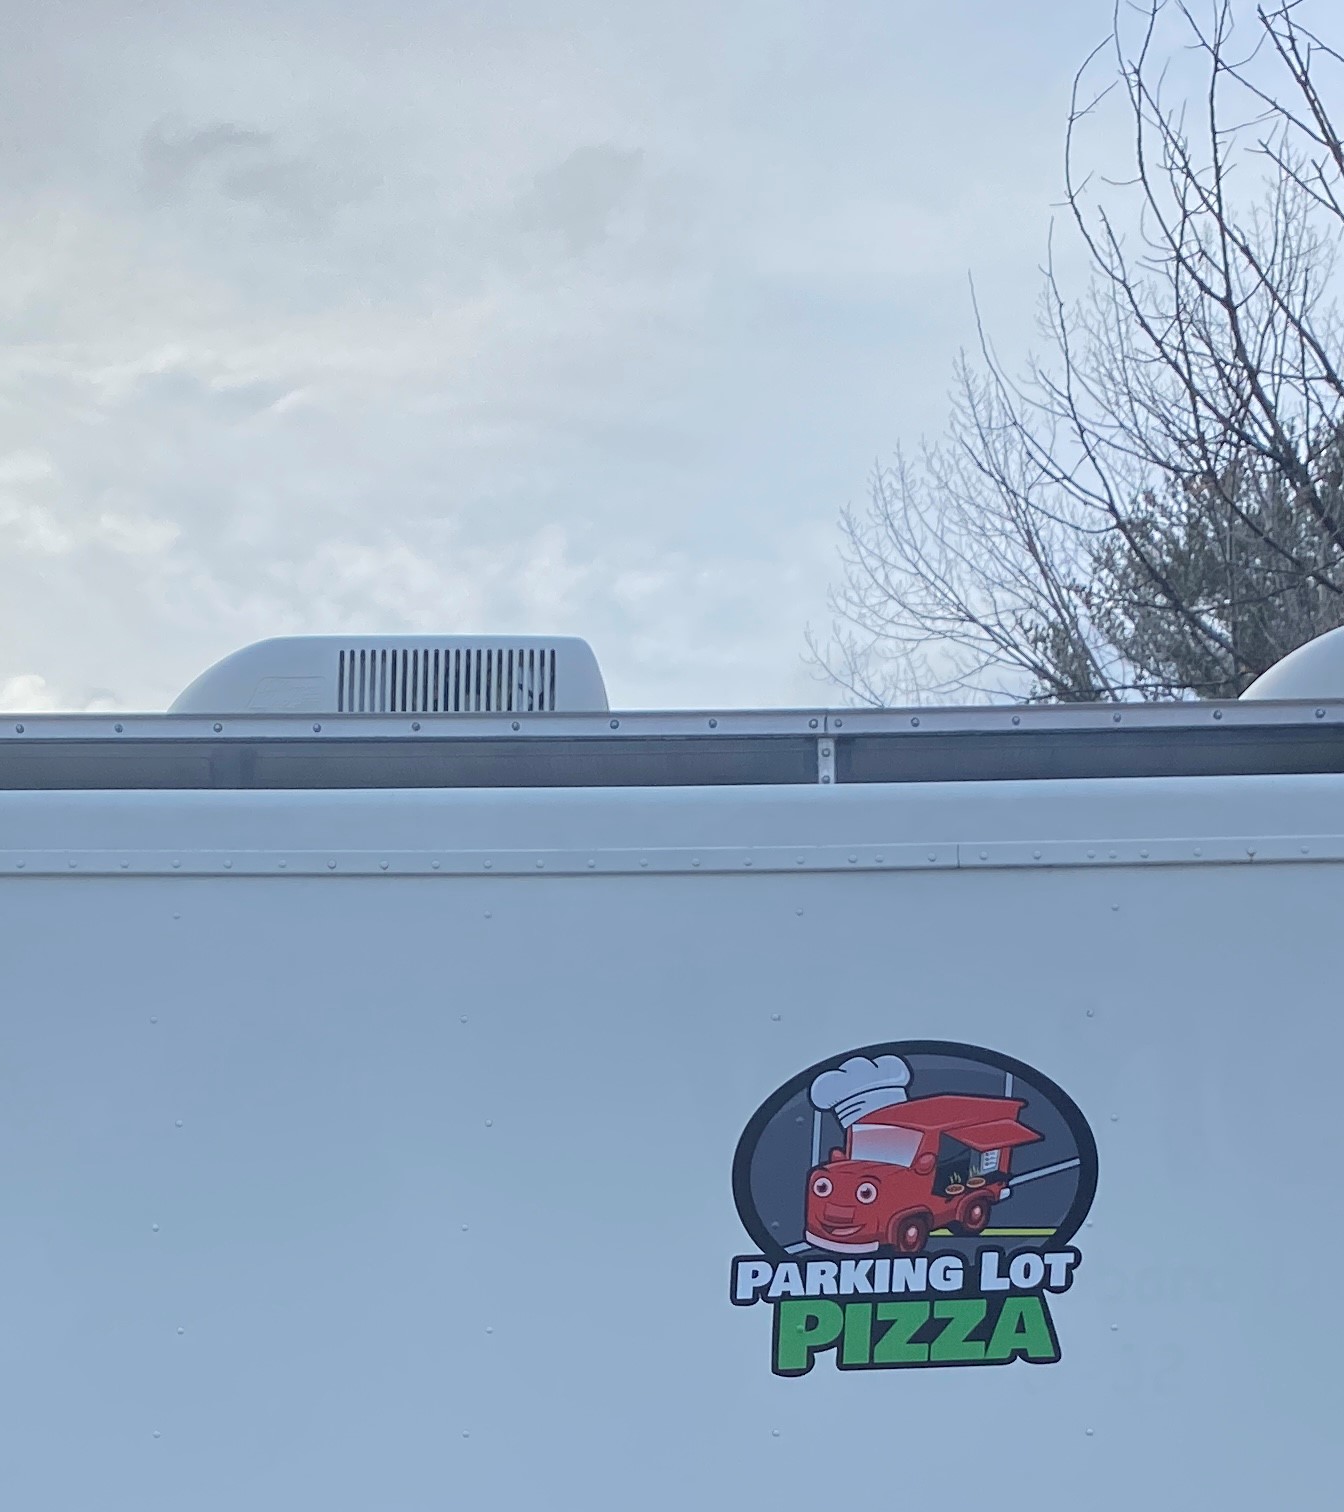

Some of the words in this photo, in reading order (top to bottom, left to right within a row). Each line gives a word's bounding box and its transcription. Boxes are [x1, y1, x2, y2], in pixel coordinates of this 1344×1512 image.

[736, 1256, 964, 1300] PARKING
[979, 1250, 1075, 1292] LOT
[777, 1296, 1056, 1370] PIZZA
